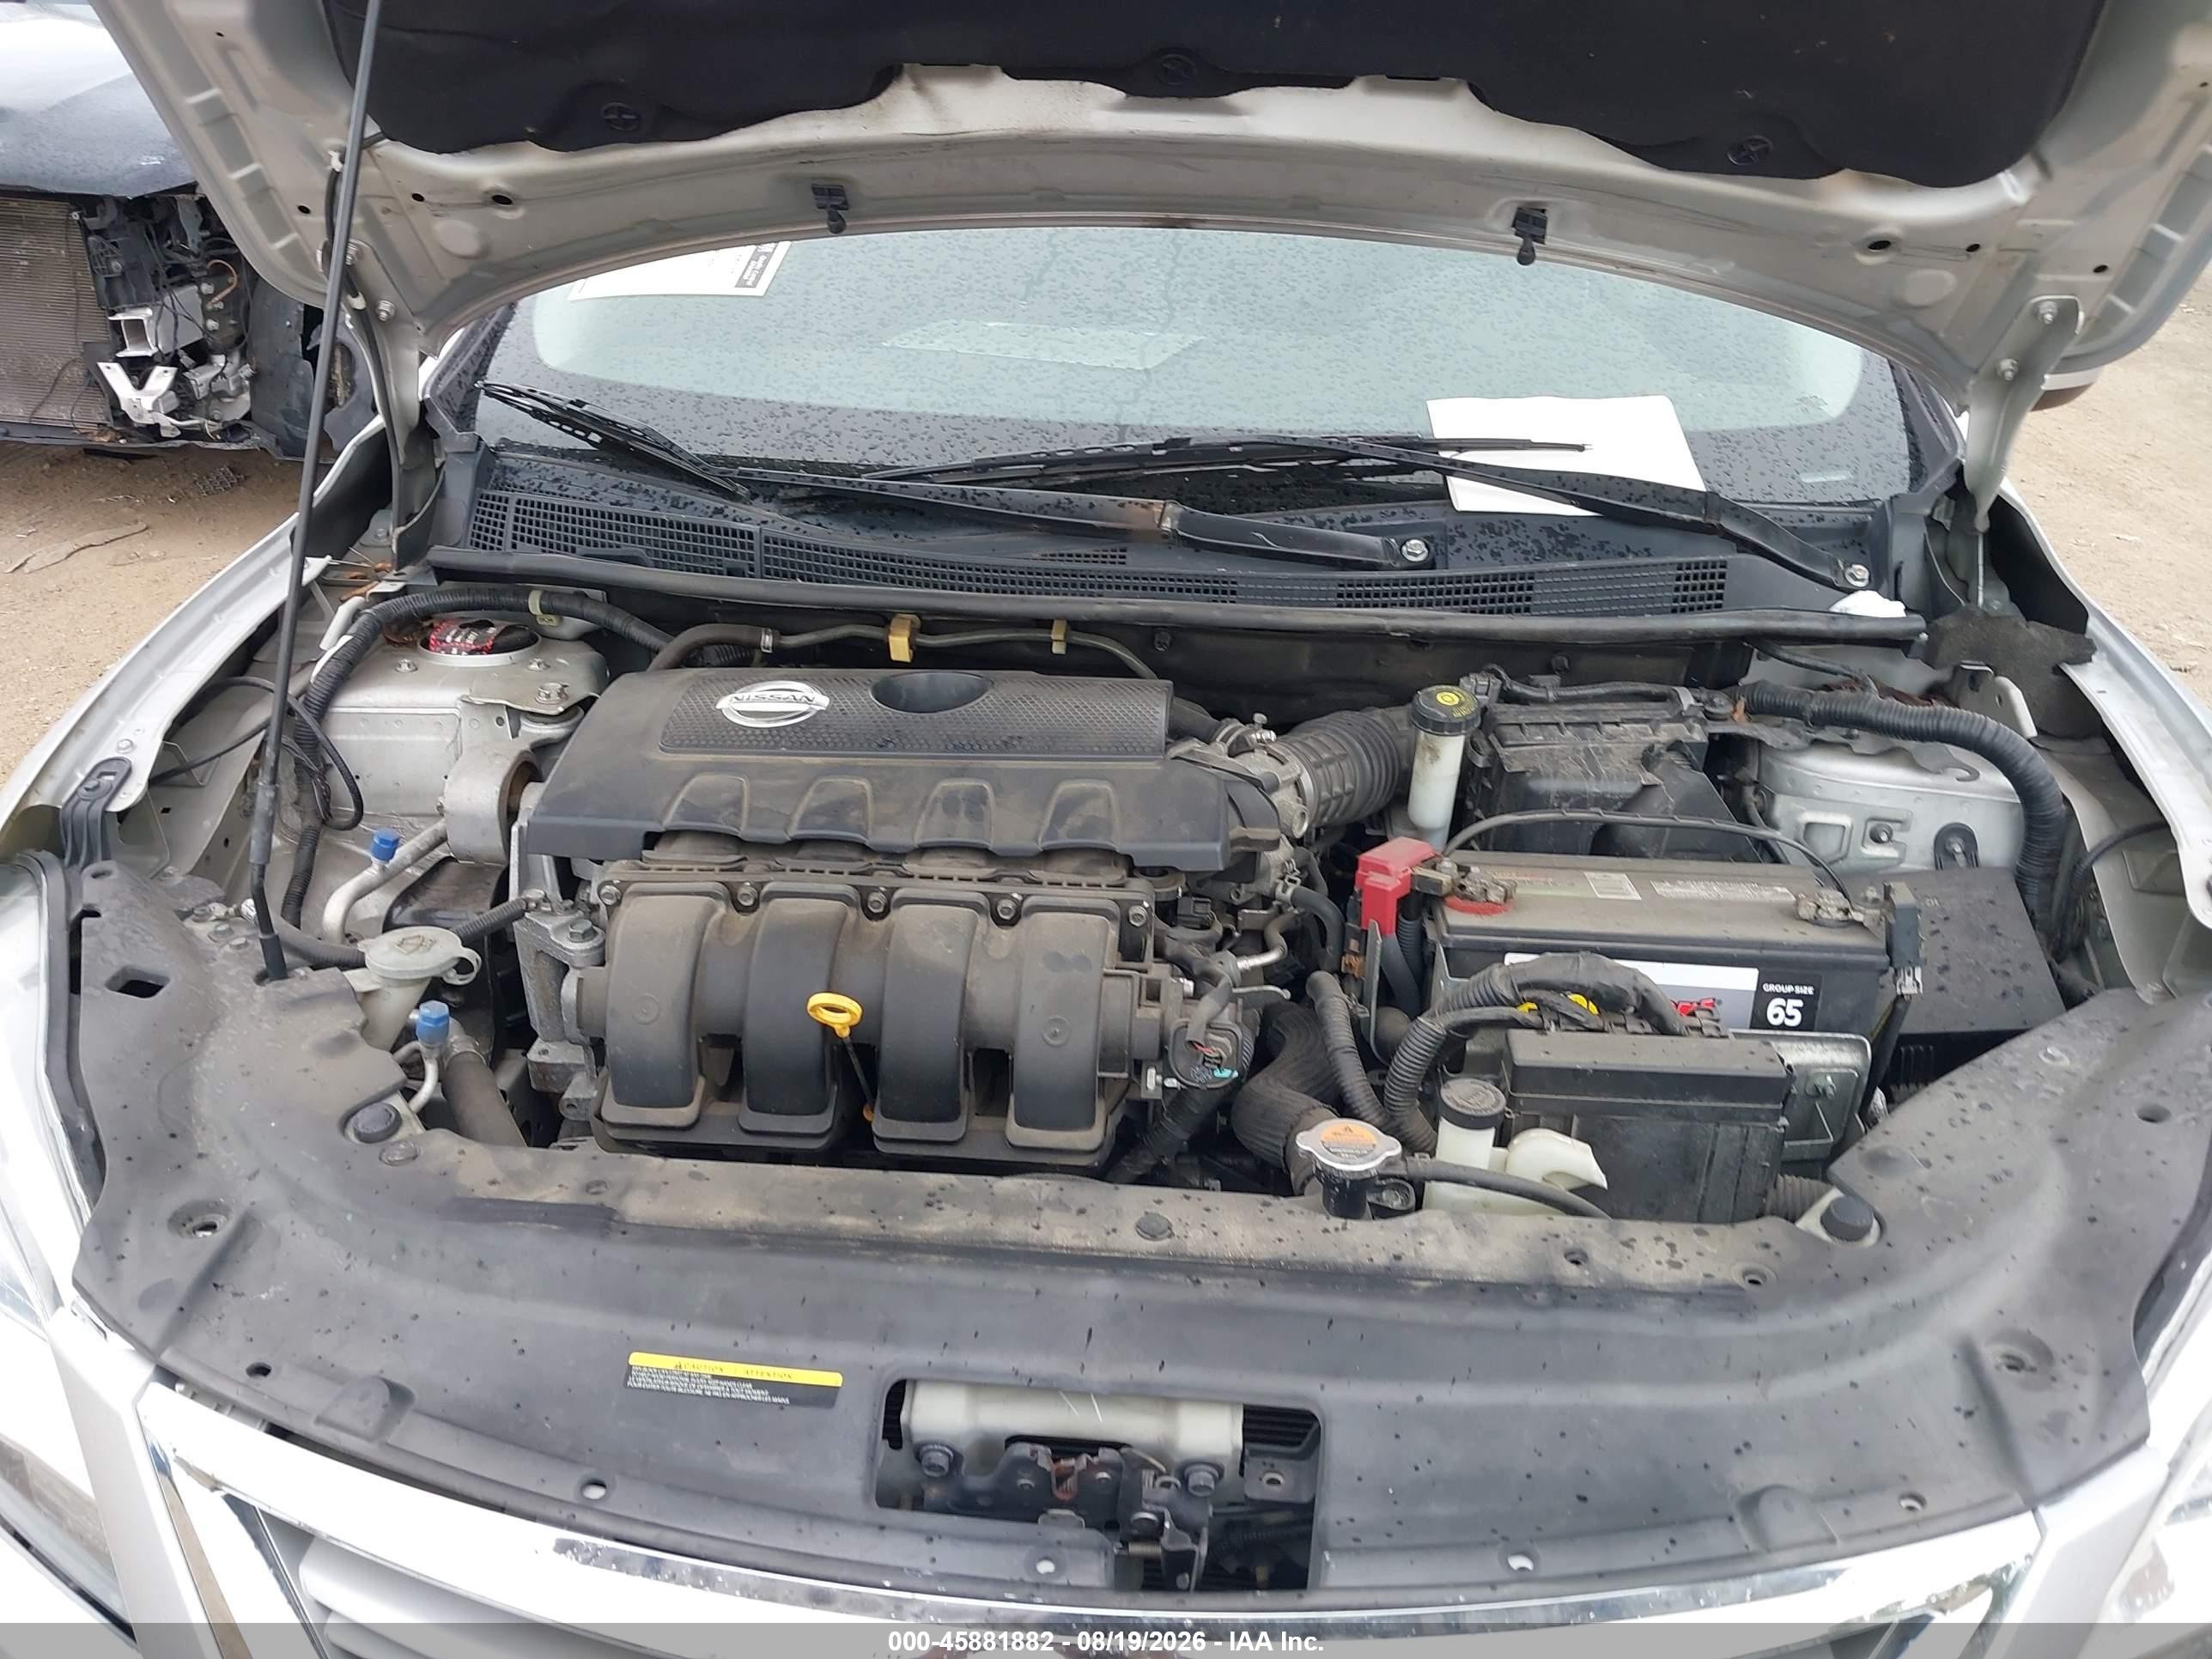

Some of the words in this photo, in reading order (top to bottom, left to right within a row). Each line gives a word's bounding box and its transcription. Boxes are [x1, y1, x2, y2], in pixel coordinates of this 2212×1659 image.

[728, 692, 816, 703] NISSAN
[1762, 982, 1795, 994] GROUP
[1795, 985, 1815, 996] SIZE
[1766, 997, 1804, 1028] 65
[684, 1362, 724, 1374] CAUTION
[744, 1369, 793, 1380] ATTENTION
